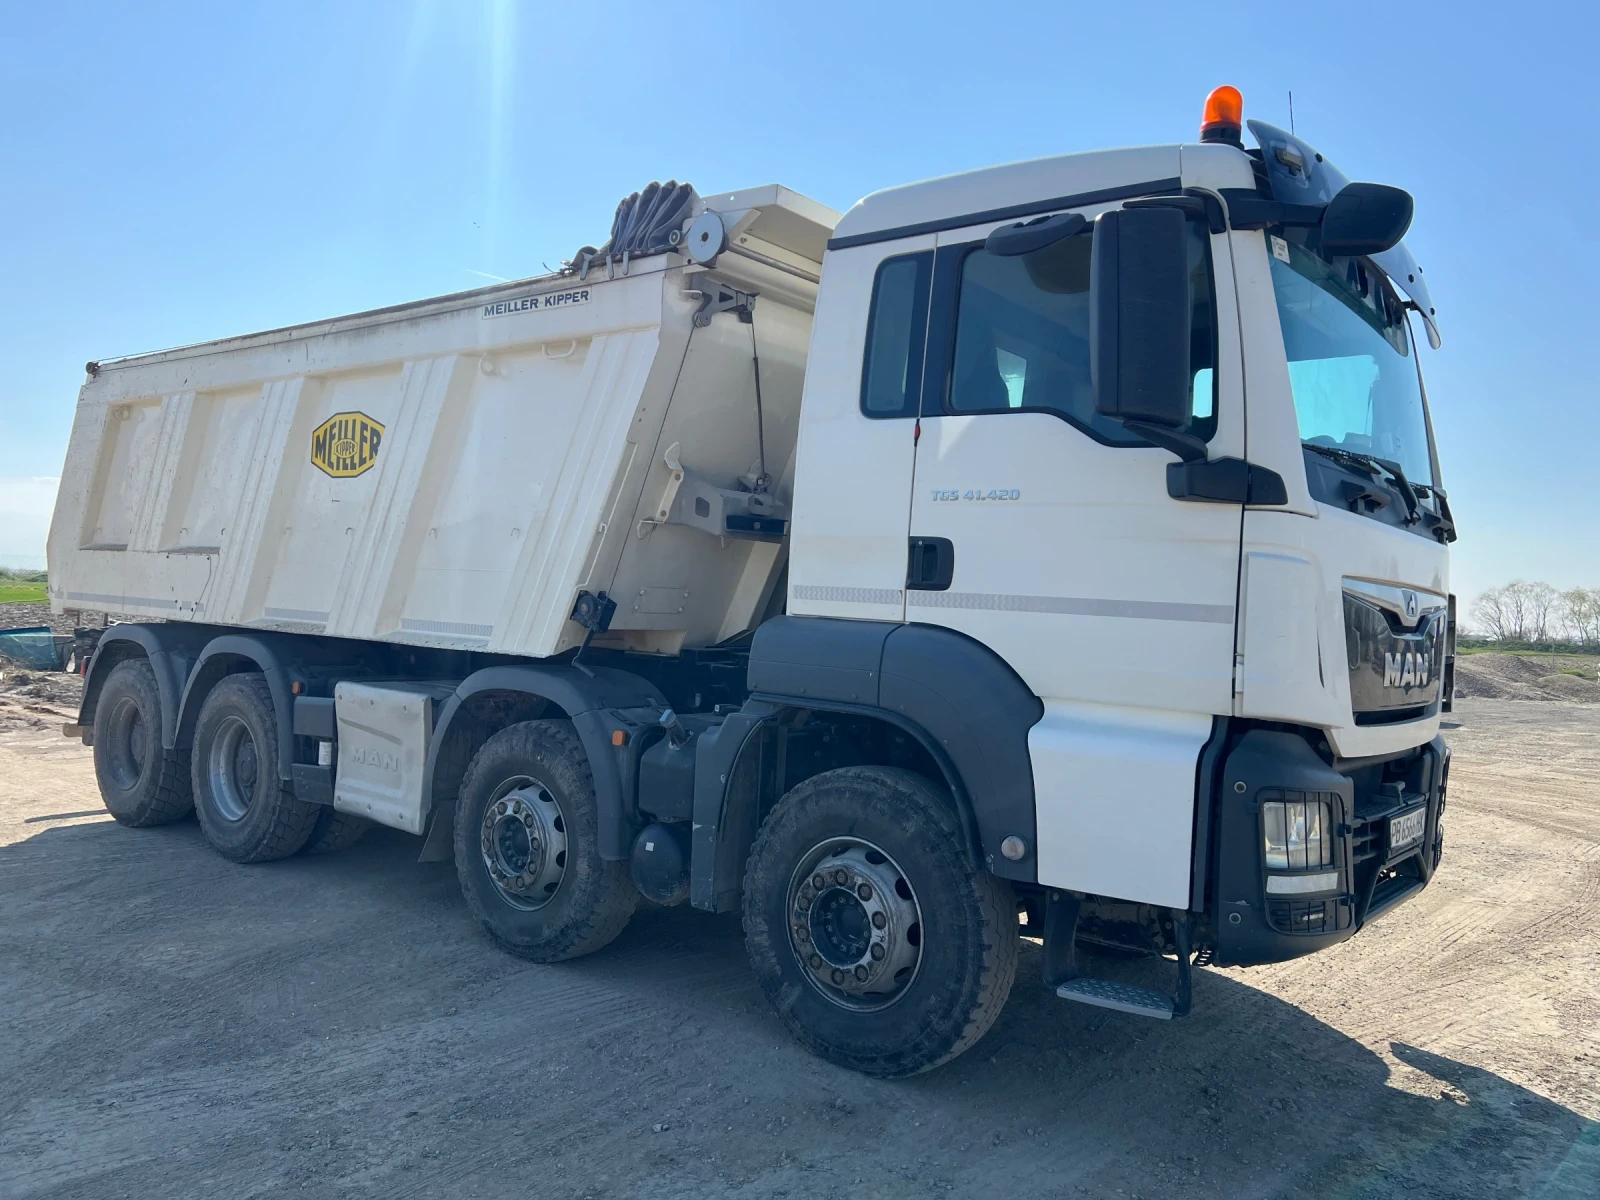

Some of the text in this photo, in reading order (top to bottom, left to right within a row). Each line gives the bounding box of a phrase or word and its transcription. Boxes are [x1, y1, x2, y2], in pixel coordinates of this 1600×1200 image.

[484, 290, 589, 317] MEILLER KIPPER
[314, 418, 382, 471] MEILLER
[335, 440, 356, 457] KIPPER
[931, 488, 1021, 501] TGS 41.420
[1383, 652, 1428, 687] MAN
[352, 747, 399, 772] MAN
